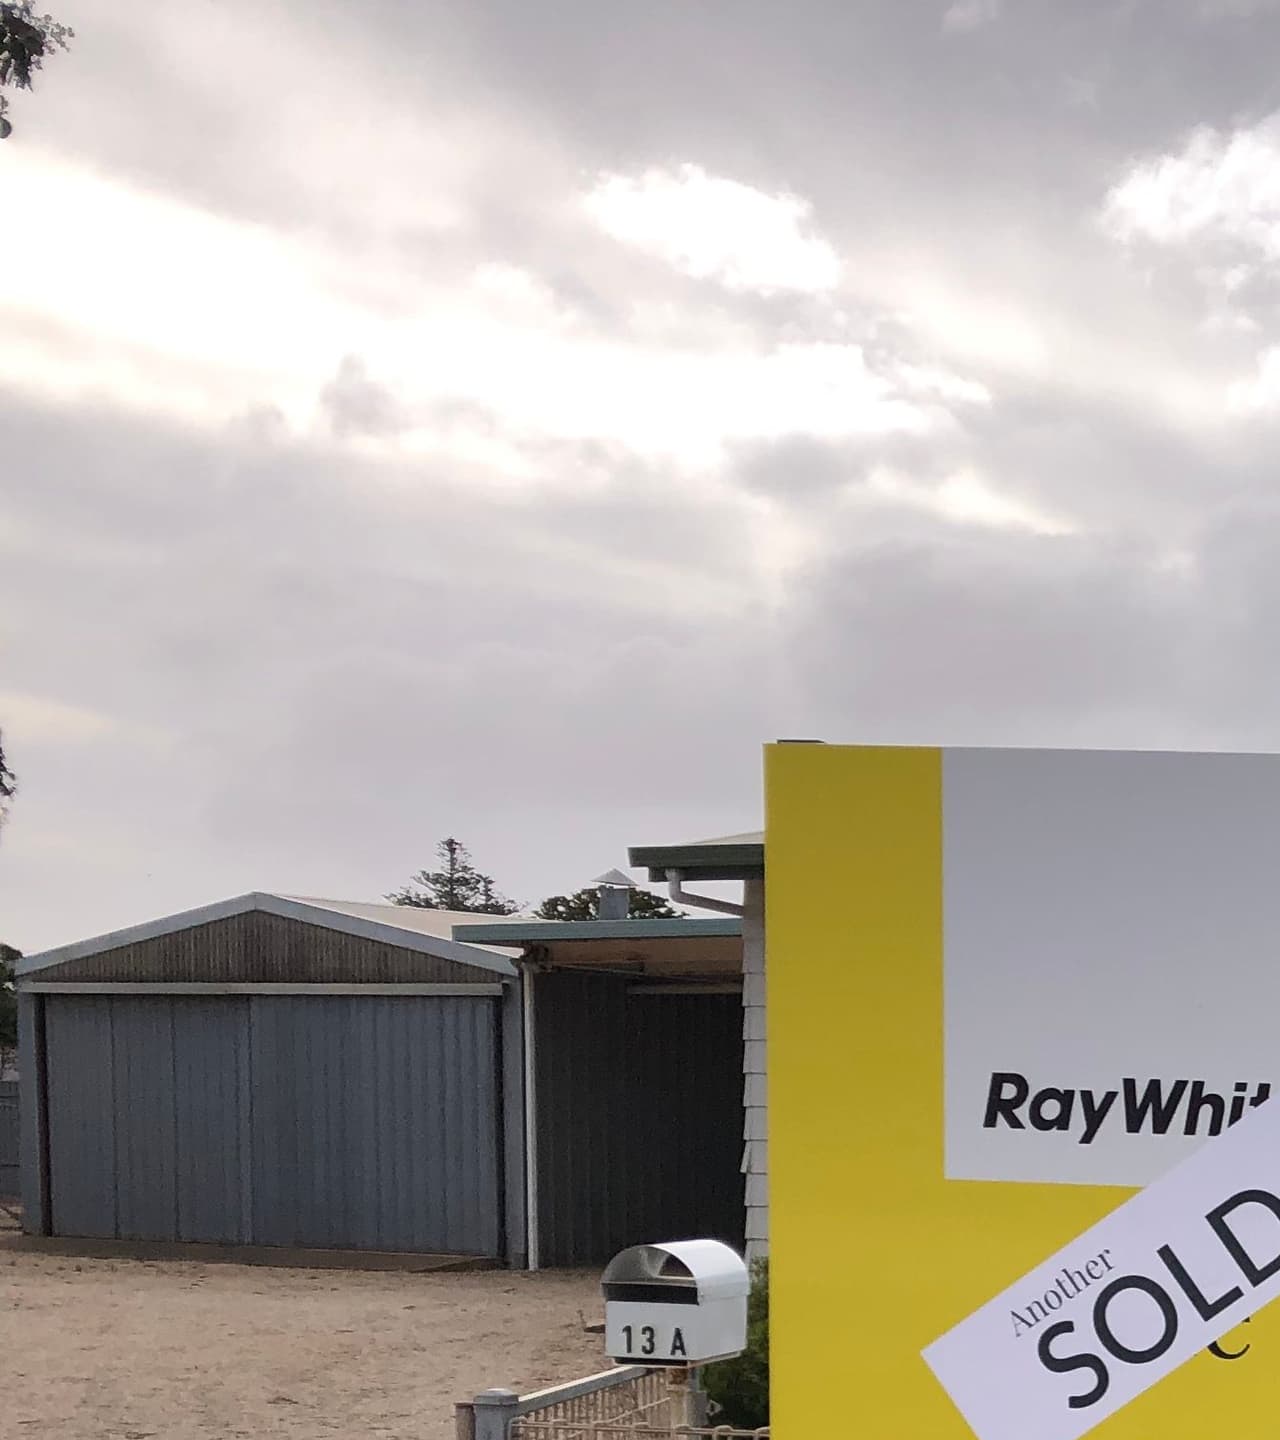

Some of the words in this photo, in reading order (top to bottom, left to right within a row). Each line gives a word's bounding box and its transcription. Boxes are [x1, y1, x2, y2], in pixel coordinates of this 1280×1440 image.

[983, 1072, 1271, 1144] RayWhi
[1010, 1248, 1115, 1337] Another
[622, 1325, 655, 1355] 13
[670, 1327, 687, 1356] A
